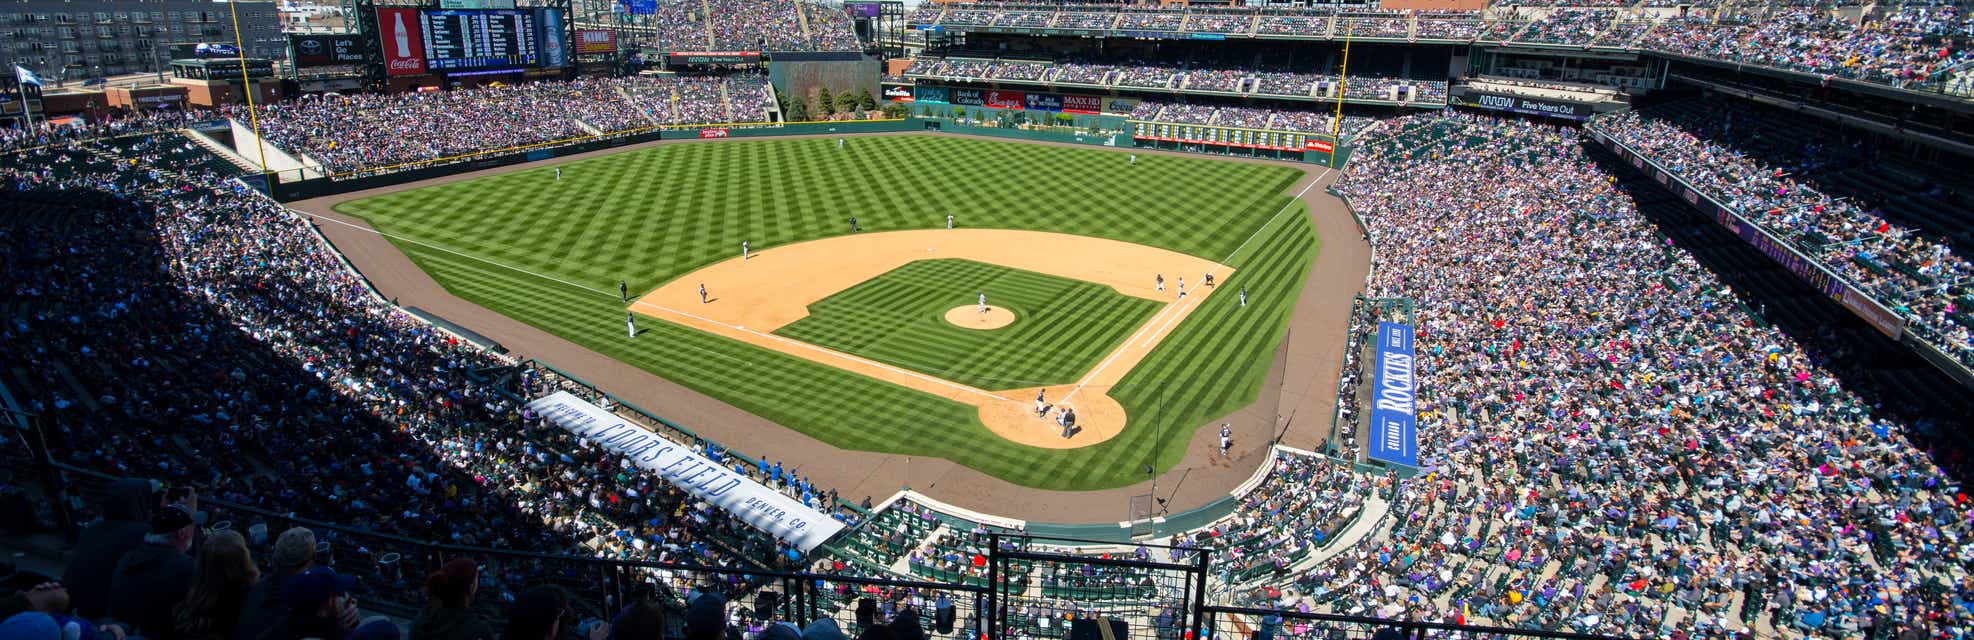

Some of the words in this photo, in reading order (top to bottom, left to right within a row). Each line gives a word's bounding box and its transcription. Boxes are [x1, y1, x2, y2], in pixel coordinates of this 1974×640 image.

[583, 31, 609, 42] KING
[335, 39, 352, 47] Let's
[957, 97, 984, 107] Colorado
[1064, 96, 1087, 104] MAXX
[1088, 97, 1100, 105] HD
[1522, 101, 1537, 110] Five
[1537, 102, 1559, 113] Years
[1559, 105, 1574, 114] Out
[1377, 351, 1414, 416] ROCKIES
[593, 423, 673, 462] COORS
[661, 455, 742, 497] FIELD
[745, 496, 786, 521] DENVER,
[788, 518, 807, 532] CO.
